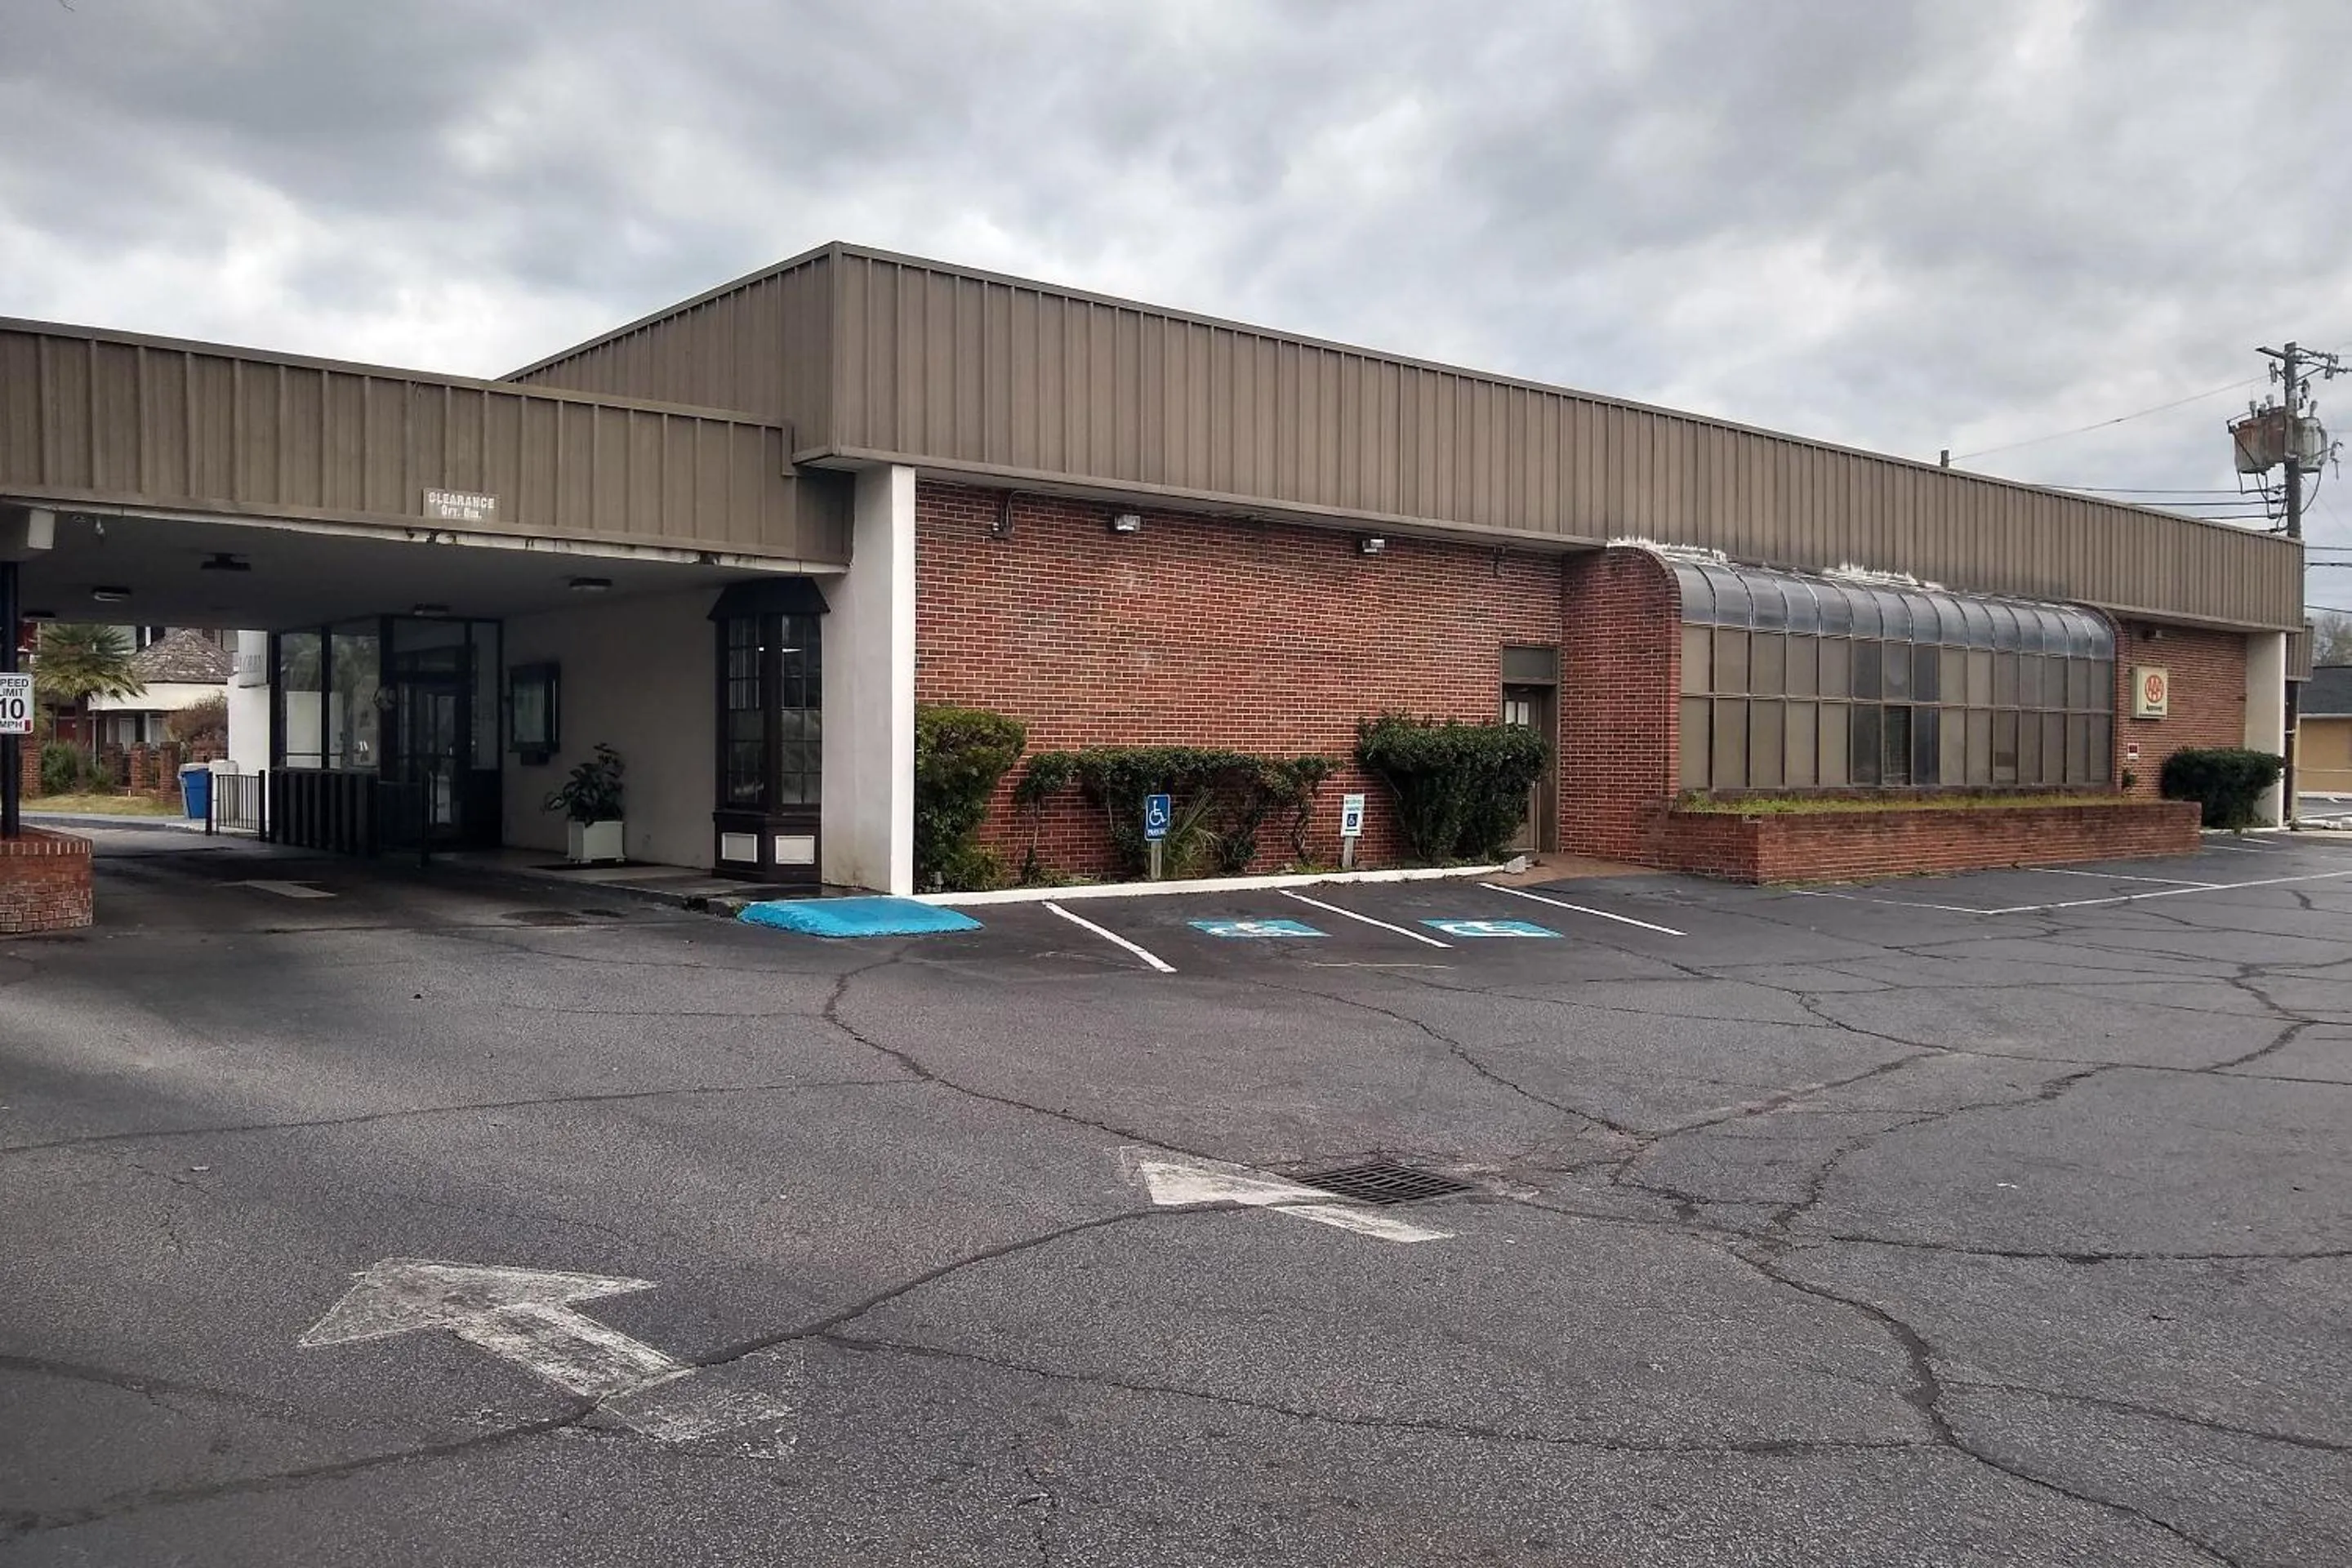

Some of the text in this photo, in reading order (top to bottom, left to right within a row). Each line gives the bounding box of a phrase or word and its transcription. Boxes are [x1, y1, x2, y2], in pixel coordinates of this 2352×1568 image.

[428, 492, 495, 509] CLEARANCE
[0, 678, 29, 687] PEED
[0, 688, 24, 697] IMIT
[0, 697, 25, 719] 10
